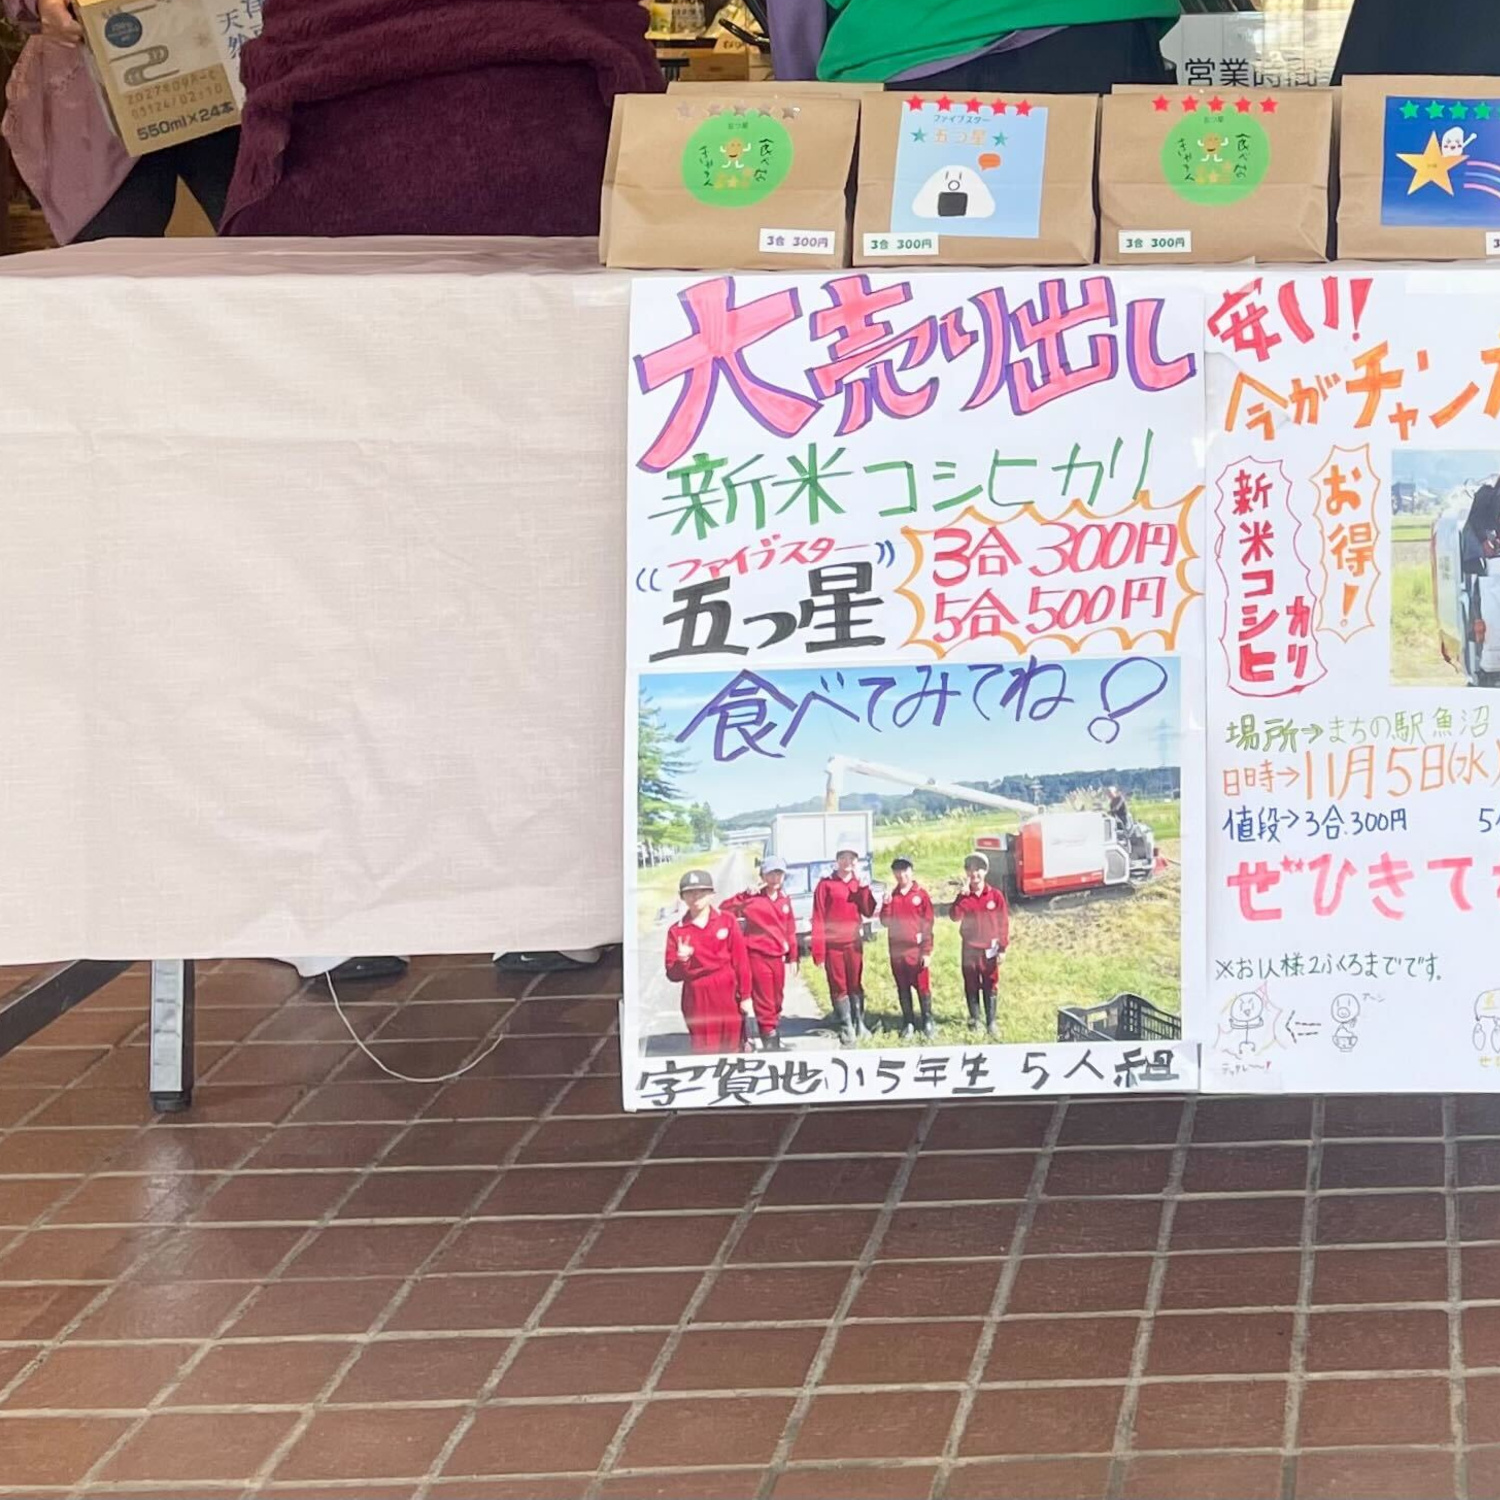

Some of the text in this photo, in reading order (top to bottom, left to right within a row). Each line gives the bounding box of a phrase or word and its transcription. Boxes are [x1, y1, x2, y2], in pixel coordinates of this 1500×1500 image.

[766, 235, 829, 249] 3合 300円
[870, 238, 933, 251] 3合 300円
[1126, 237, 1186, 249] 3合 300円
[1206, 276, 1374, 362] 安い!
[632, 273, 1198, 473] 大売り出し
[647, 428, 1156, 540] 新米コシヒカリ
[932, 521, 1180, 587] 3合 300円
[933, 576, 1168, 644] 5合 500円
